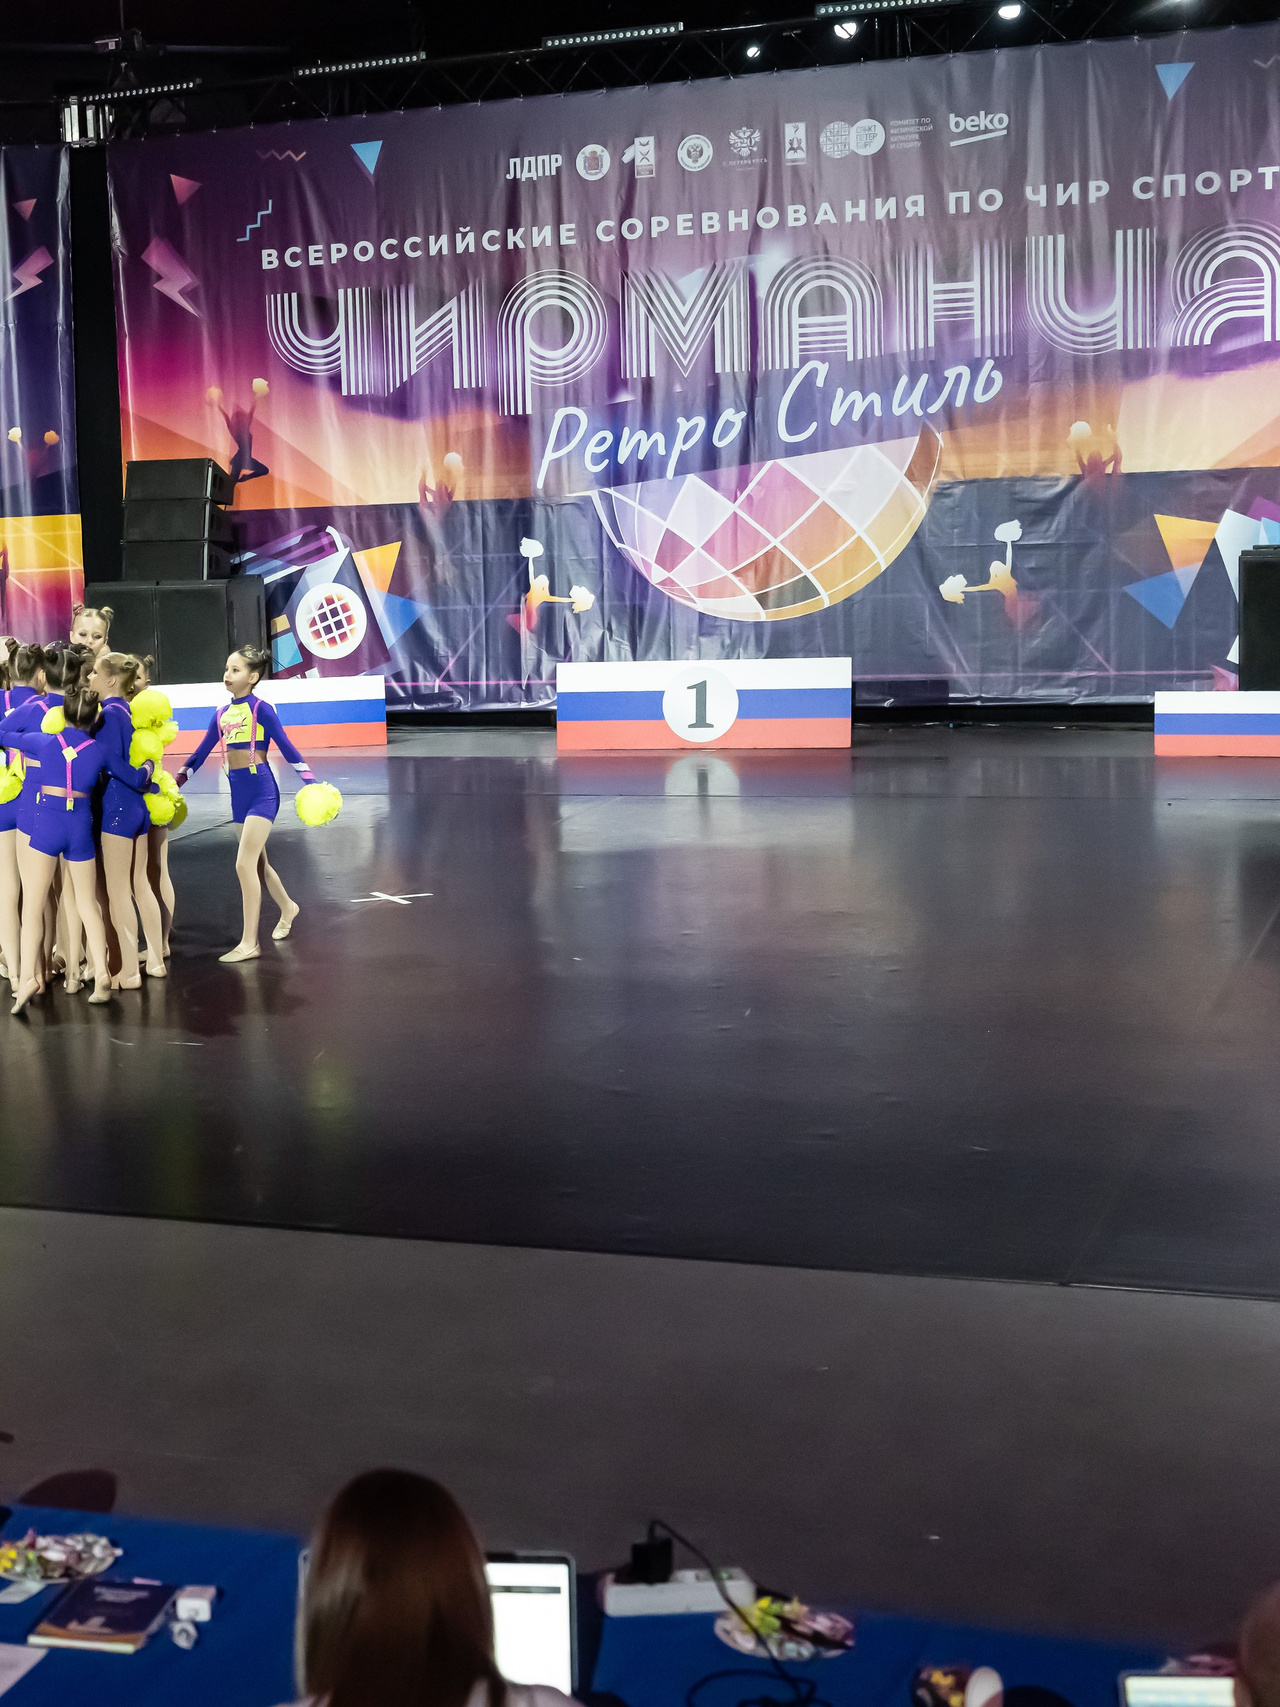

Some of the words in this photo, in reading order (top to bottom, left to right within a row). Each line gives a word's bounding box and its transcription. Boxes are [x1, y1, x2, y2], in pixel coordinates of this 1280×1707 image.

[889, 118, 920, 127] КОМИТЕТ
[889, 124, 934, 134] ФИЗИЧЕСКОЙ
[949, 110, 1009, 133] beko
[506, 154, 562, 182] ЛДПР
[261, 223, 578, 270] ВСЕРОССИЙСКИЕ
[595, 195, 926, 242] СОРЕВНОВАНИЯ
[949, 188, 1004, 216] ПО
[1025, 180, 1110, 207] ЧИР
[1132, 165, 1280, 200] СПОРТ
[536, 406, 747, 490] Ретро
[777, 359, 1004, 444] Стиль
[687, 680, 714, 728] 1
